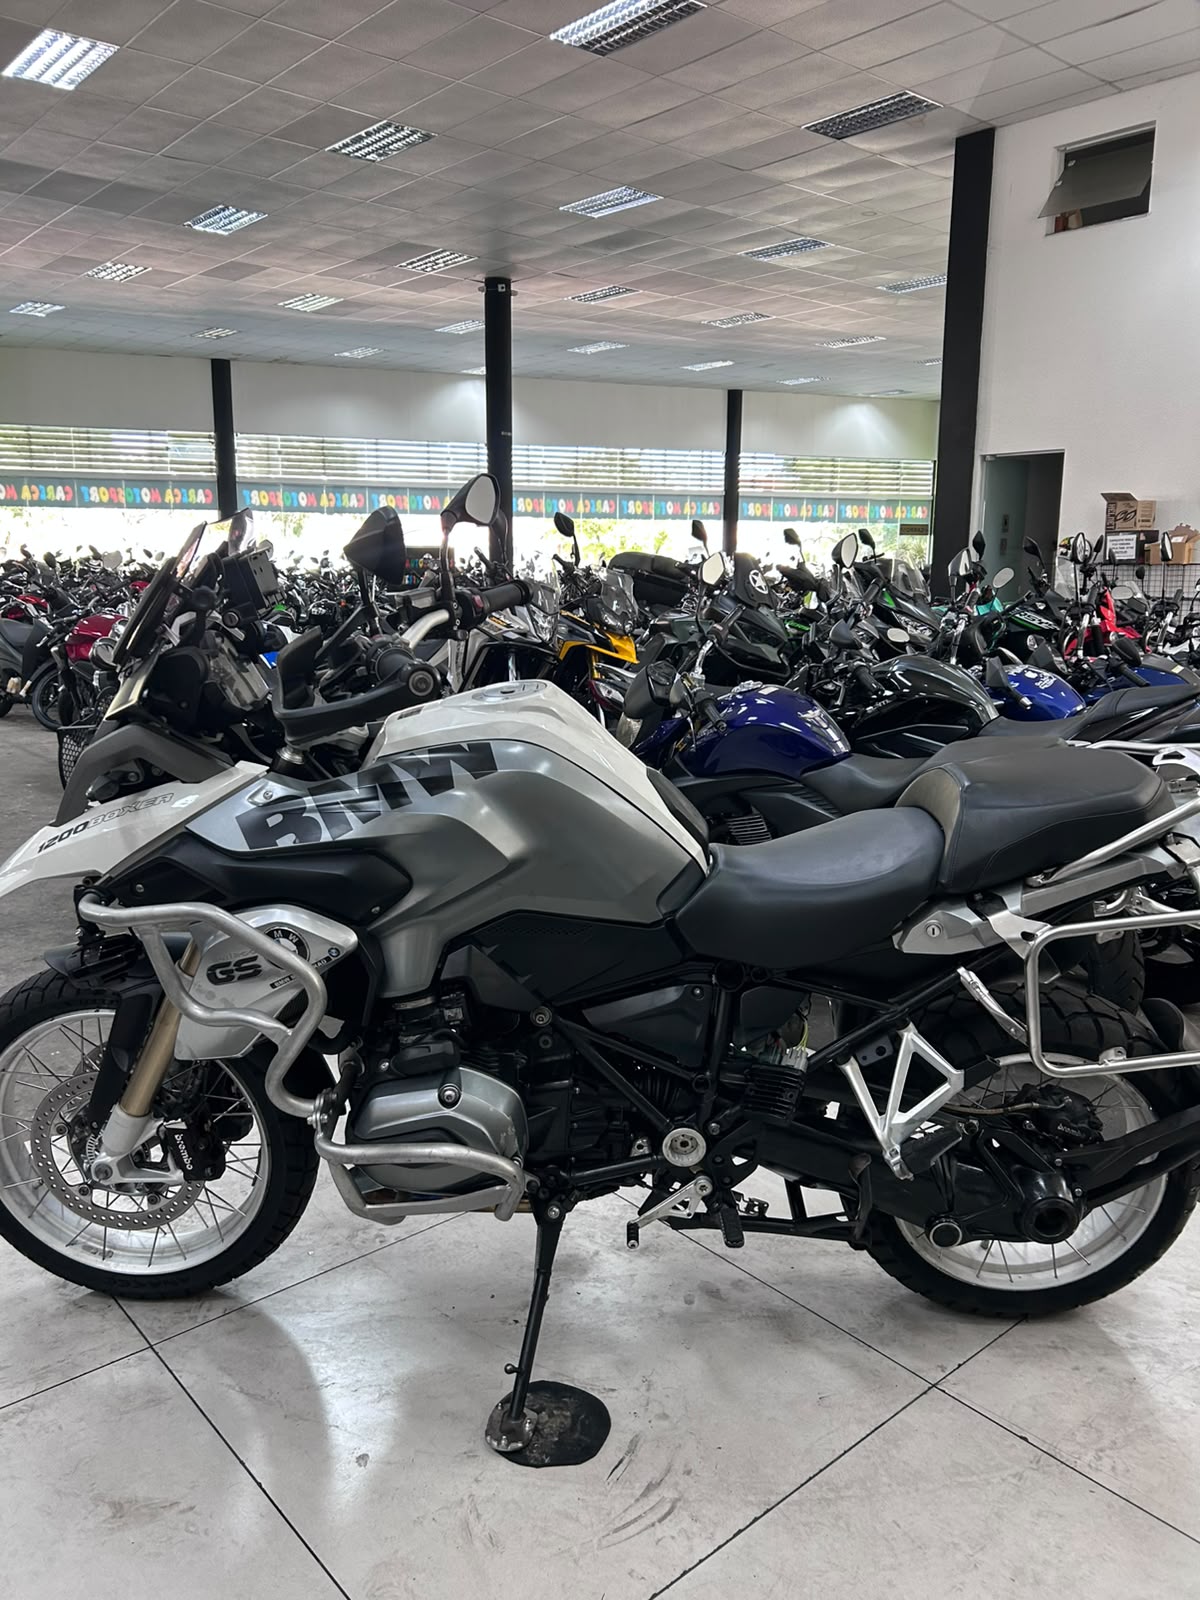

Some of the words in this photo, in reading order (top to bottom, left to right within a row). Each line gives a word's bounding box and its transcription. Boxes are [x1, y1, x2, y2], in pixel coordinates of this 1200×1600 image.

[235, 742, 498, 850] BMW
[206, 955, 262, 986] GS
[174, 1133, 194, 1171] brembo
